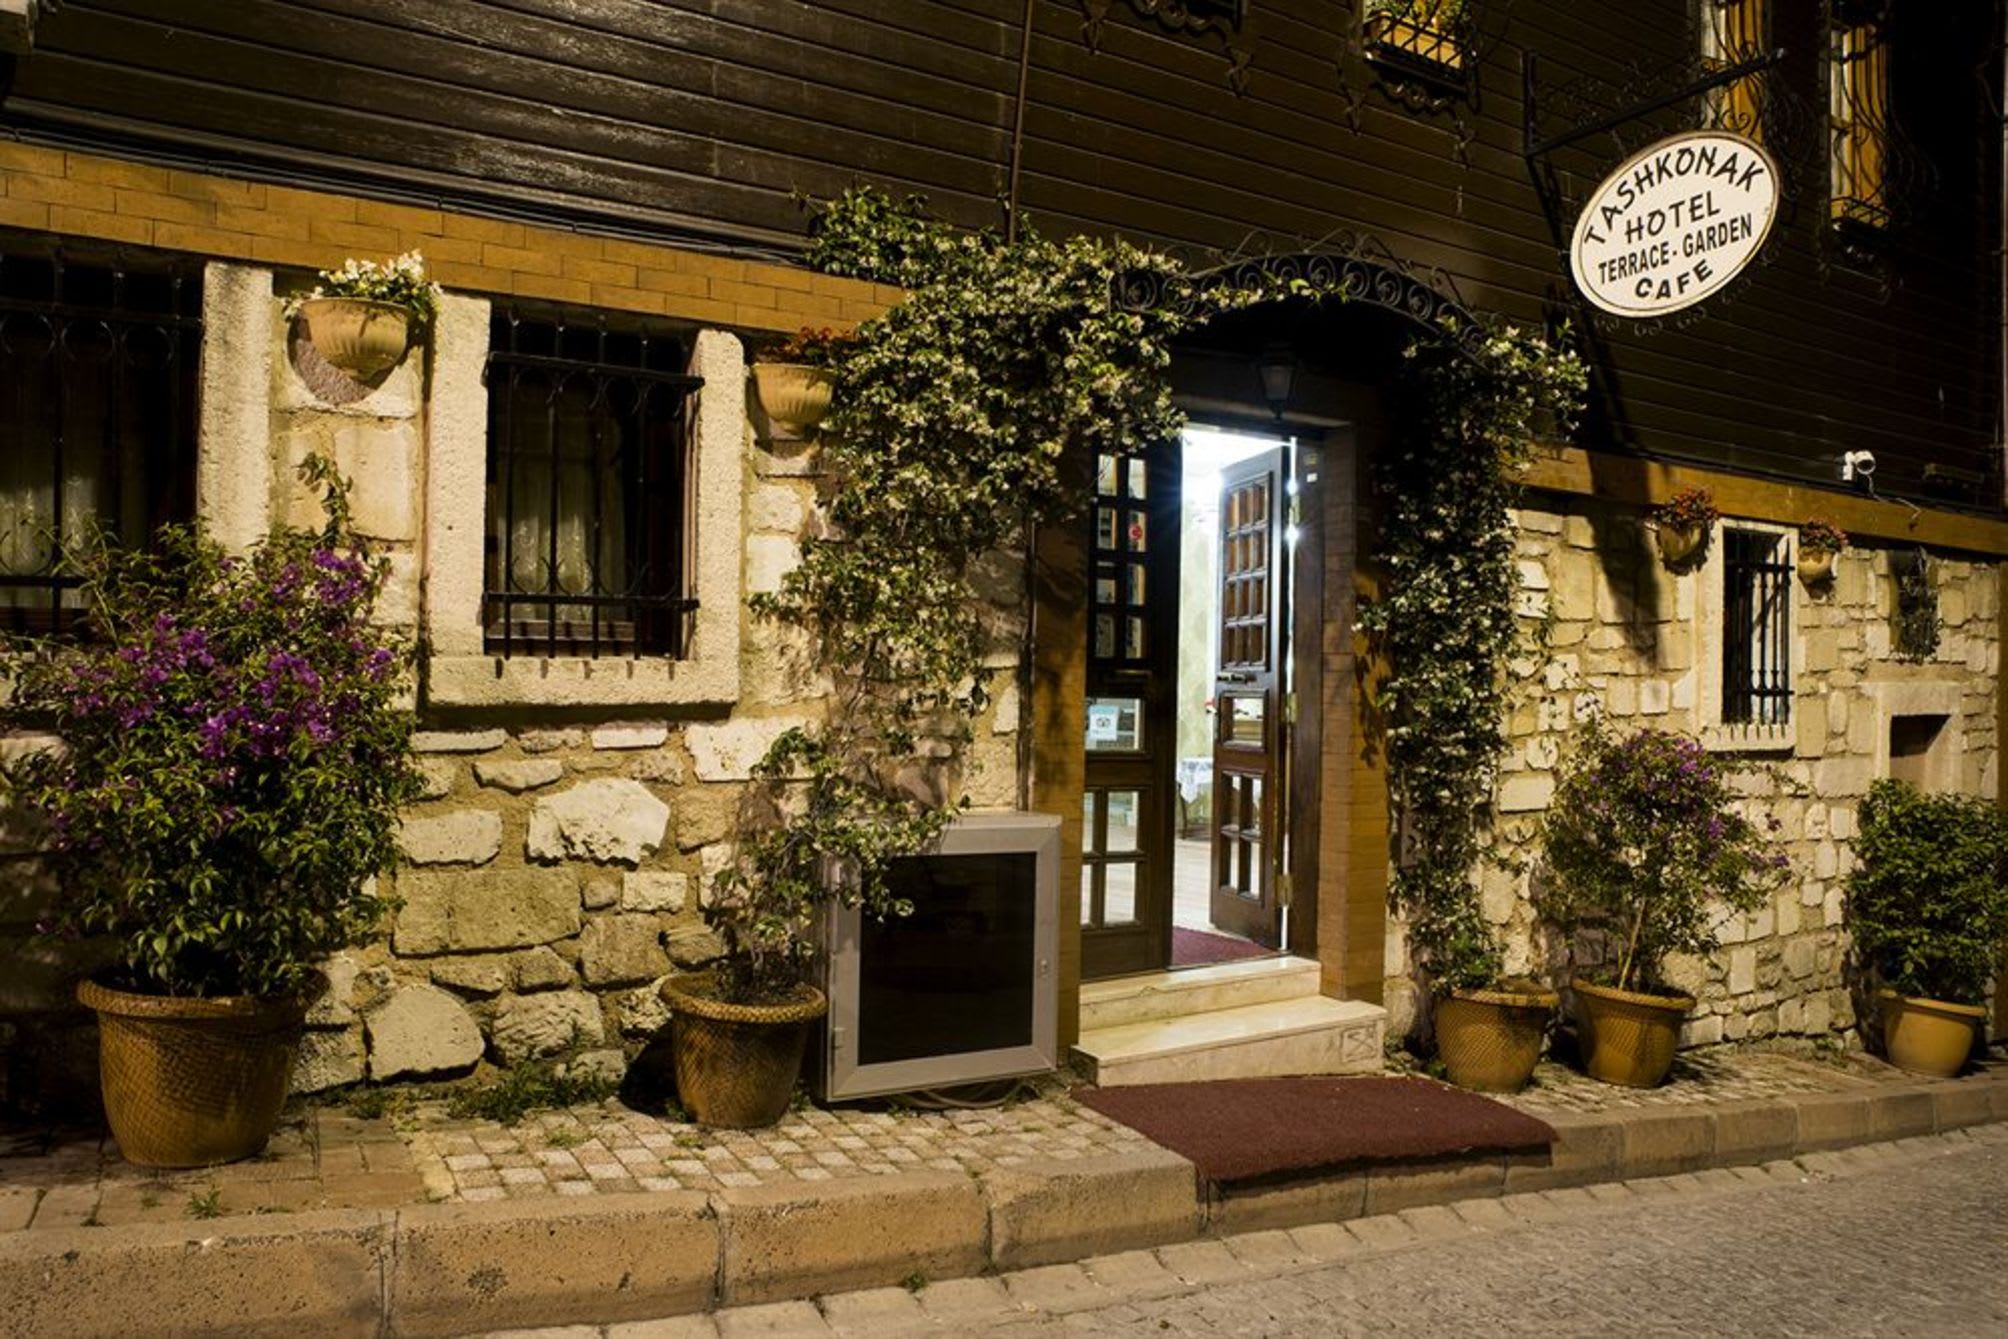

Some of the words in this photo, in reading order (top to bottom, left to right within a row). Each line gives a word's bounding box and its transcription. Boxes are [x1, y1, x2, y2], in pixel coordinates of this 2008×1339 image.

[1584, 146, 1764, 247] TASHKONAK
[1625, 191, 1721, 244] HOTEL
[1635, 259, 1713, 300] CAFE
